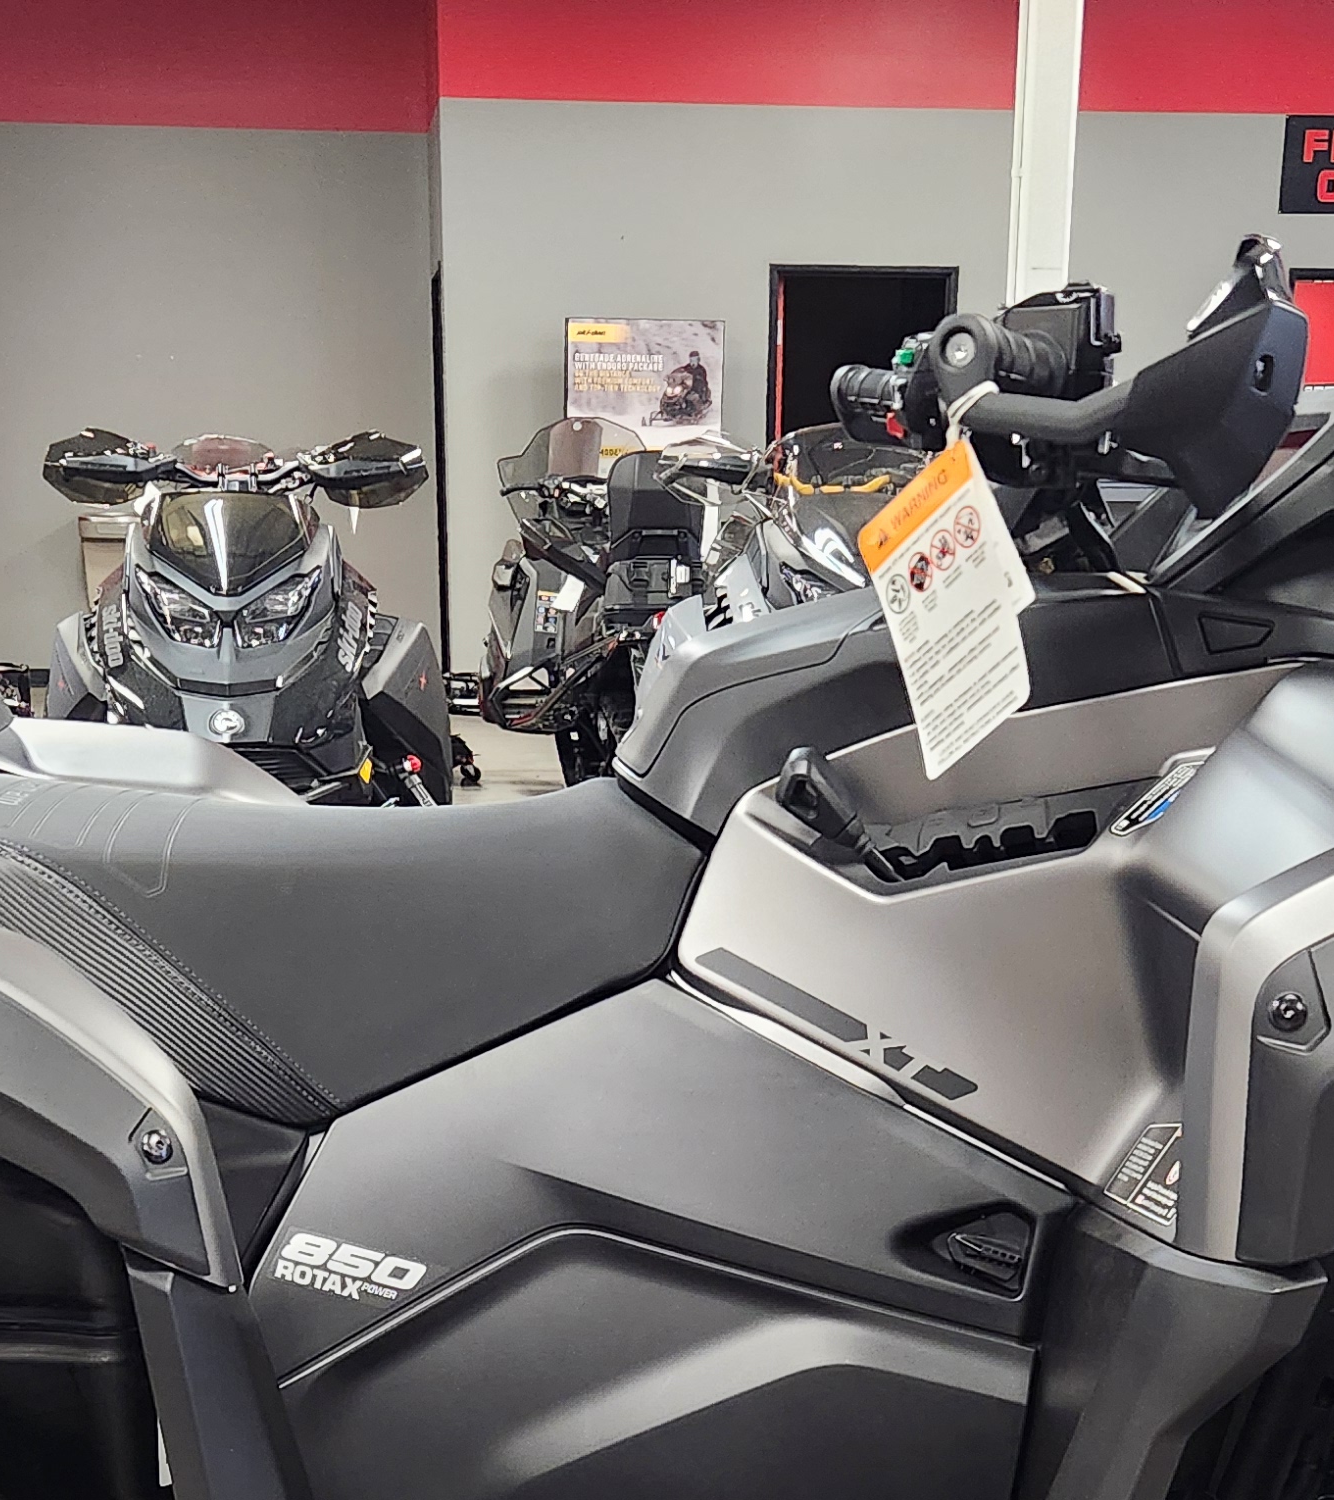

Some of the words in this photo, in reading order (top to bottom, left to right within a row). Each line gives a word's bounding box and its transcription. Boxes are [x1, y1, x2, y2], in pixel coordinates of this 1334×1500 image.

[574, 361, 595, 370] WITH
[890, 471, 948, 530] WARNING
[102, 604, 124, 668] ski-doo
[338, 601, 363, 673] ski-doo
[274, 1259, 363, 1300] ROTAX
[361, 1282, 398, 1300] POWER
[280, 1232, 427, 1290] 850
